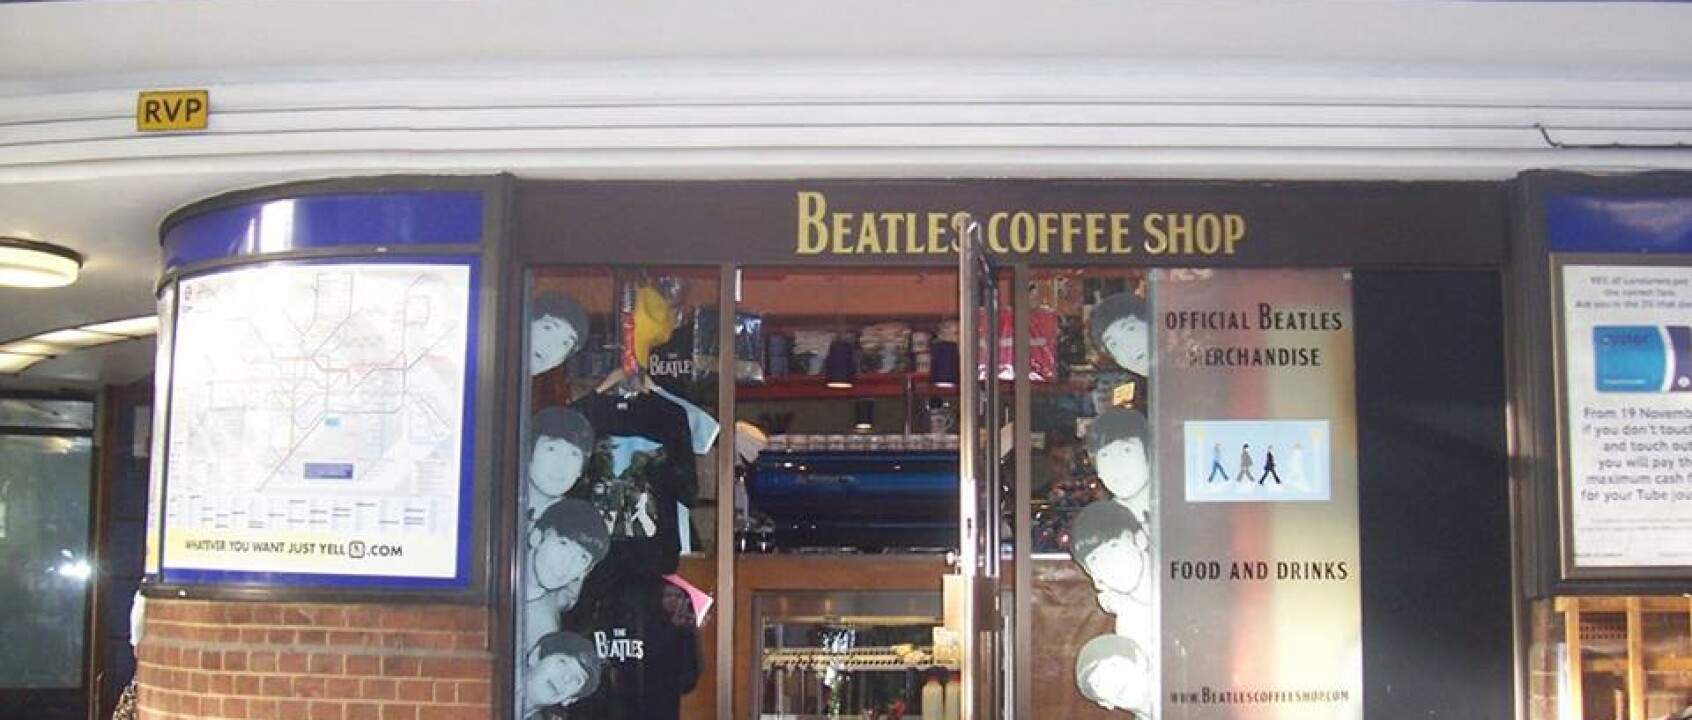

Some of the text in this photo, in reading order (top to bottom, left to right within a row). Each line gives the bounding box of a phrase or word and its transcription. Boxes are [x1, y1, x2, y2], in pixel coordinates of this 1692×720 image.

[145, 99, 202, 122] RVP
[988, 212, 1130, 254] COFFEE
[1143, 213, 1246, 254] SHOP
[1165, 302, 1343, 331] OFFICIAL BEATLES
[1187, 348, 1321, 366] ERCHANDISE
[1594, 426, 1619, 438] you
[1630, 441, 1668, 451] touch
[1598, 459, 1622, 470] you
[1652, 459, 1674, 470] pay
[1655, 473, 1683, 484] cash
[1604, 491, 1633, 503] your
[229, 541, 249, 552] YOU
[253, 542, 285, 553] WANT
[288, 542, 315, 554] JUST
[319, 543, 345, 555] YELL
[1170, 561, 1348, 580] FOOD AND DRINKS
